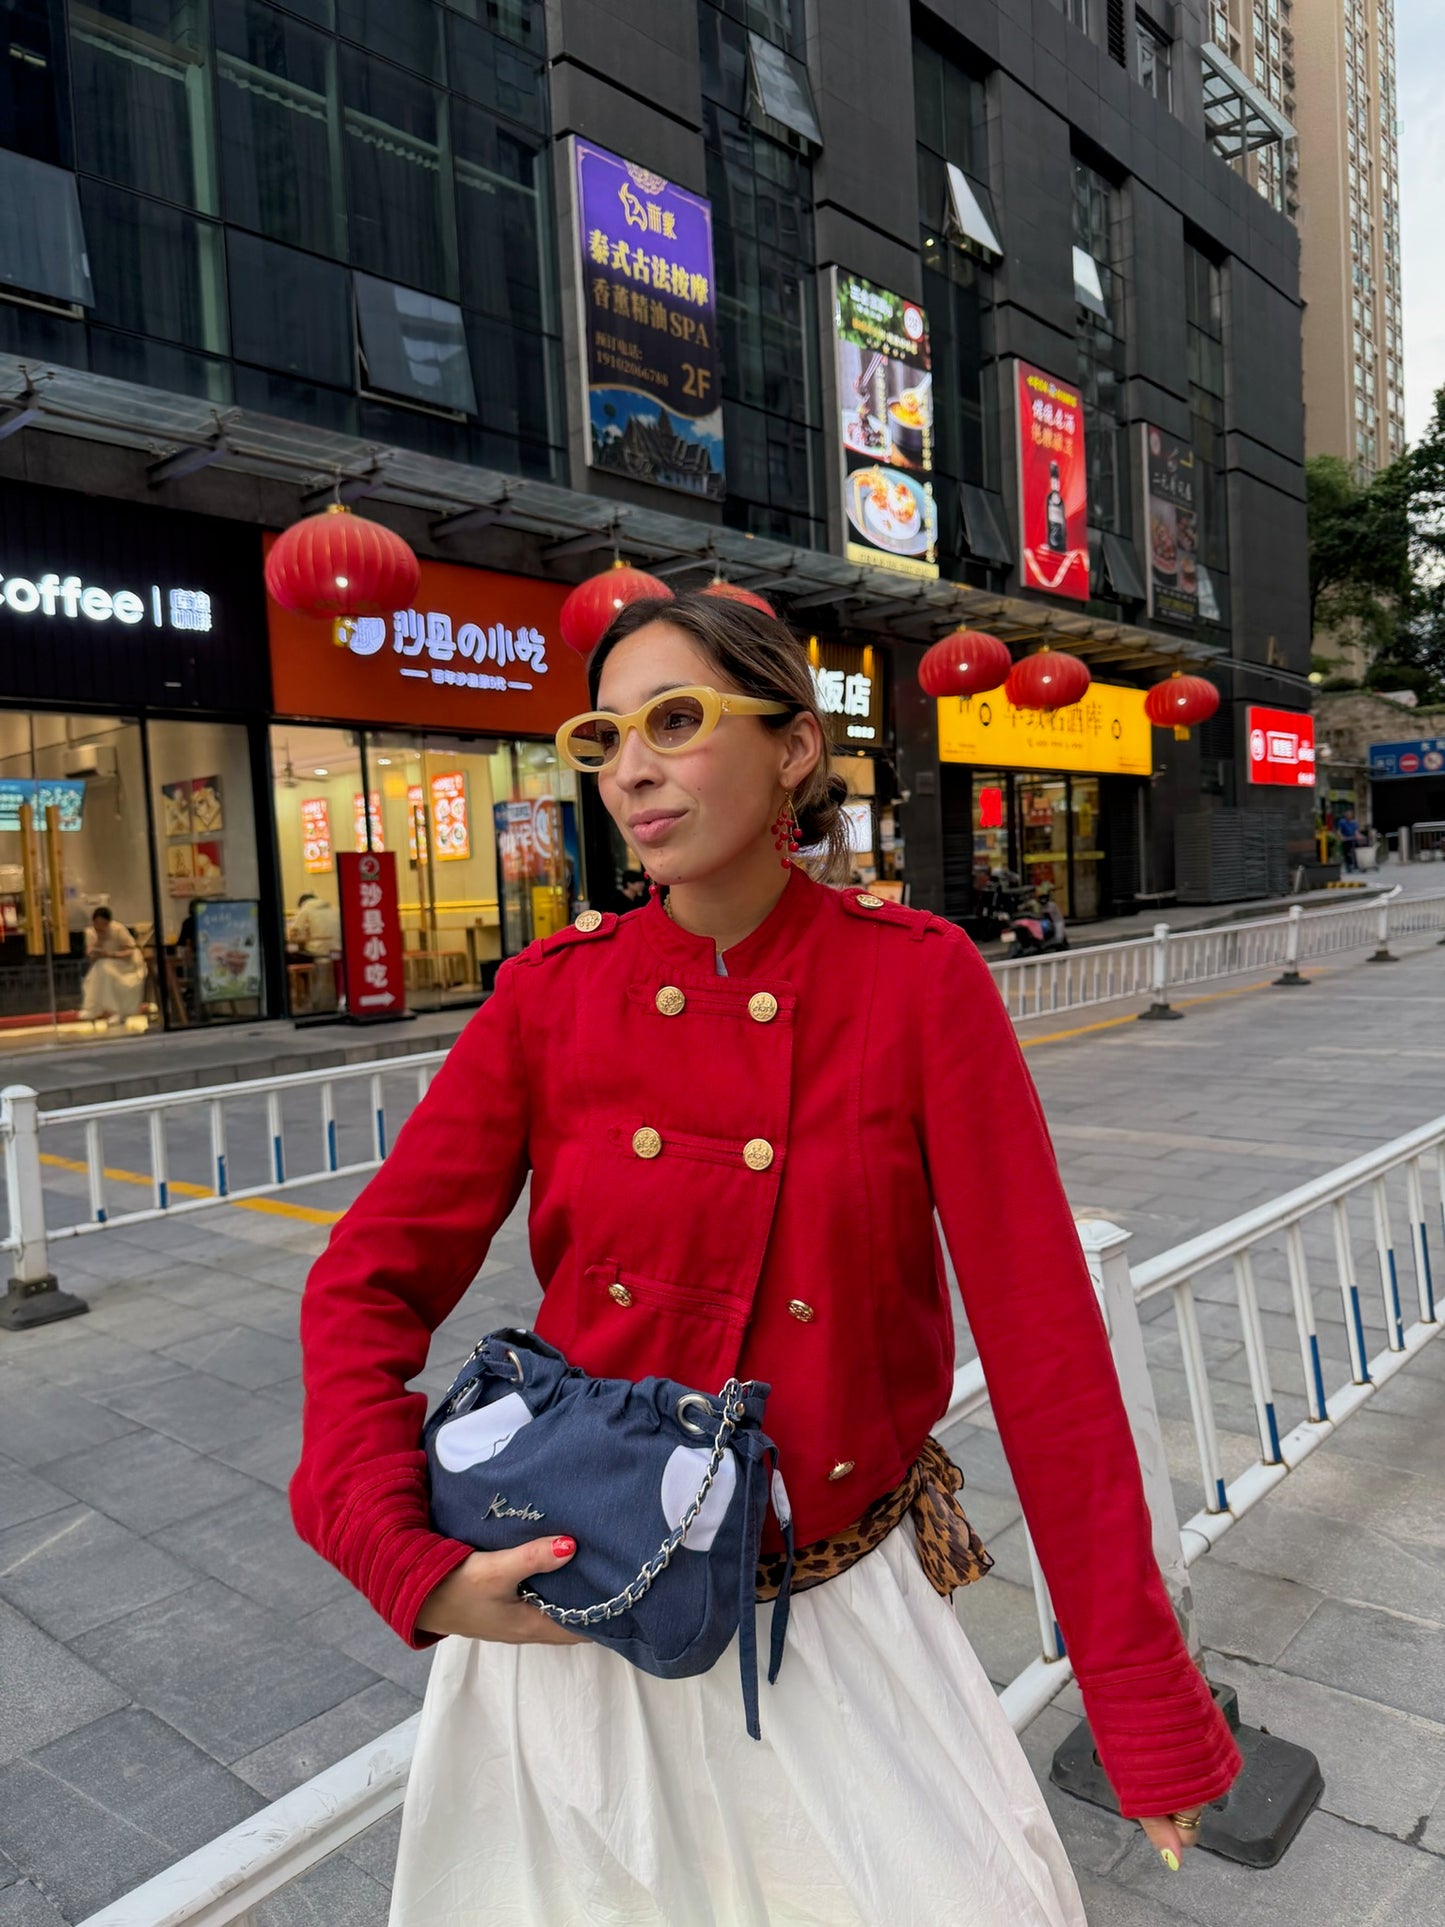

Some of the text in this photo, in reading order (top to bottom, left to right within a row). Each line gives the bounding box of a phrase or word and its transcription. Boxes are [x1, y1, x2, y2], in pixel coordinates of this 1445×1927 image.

[589, 229, 708, 306] 泰式古法按摩
[681, 362, 711, 399] 2F
[0, 573, 144, 624] offee
[393, 608, 548, 673] 沙县の小吃
[359, 881, 388, 989] 沙县小吃
